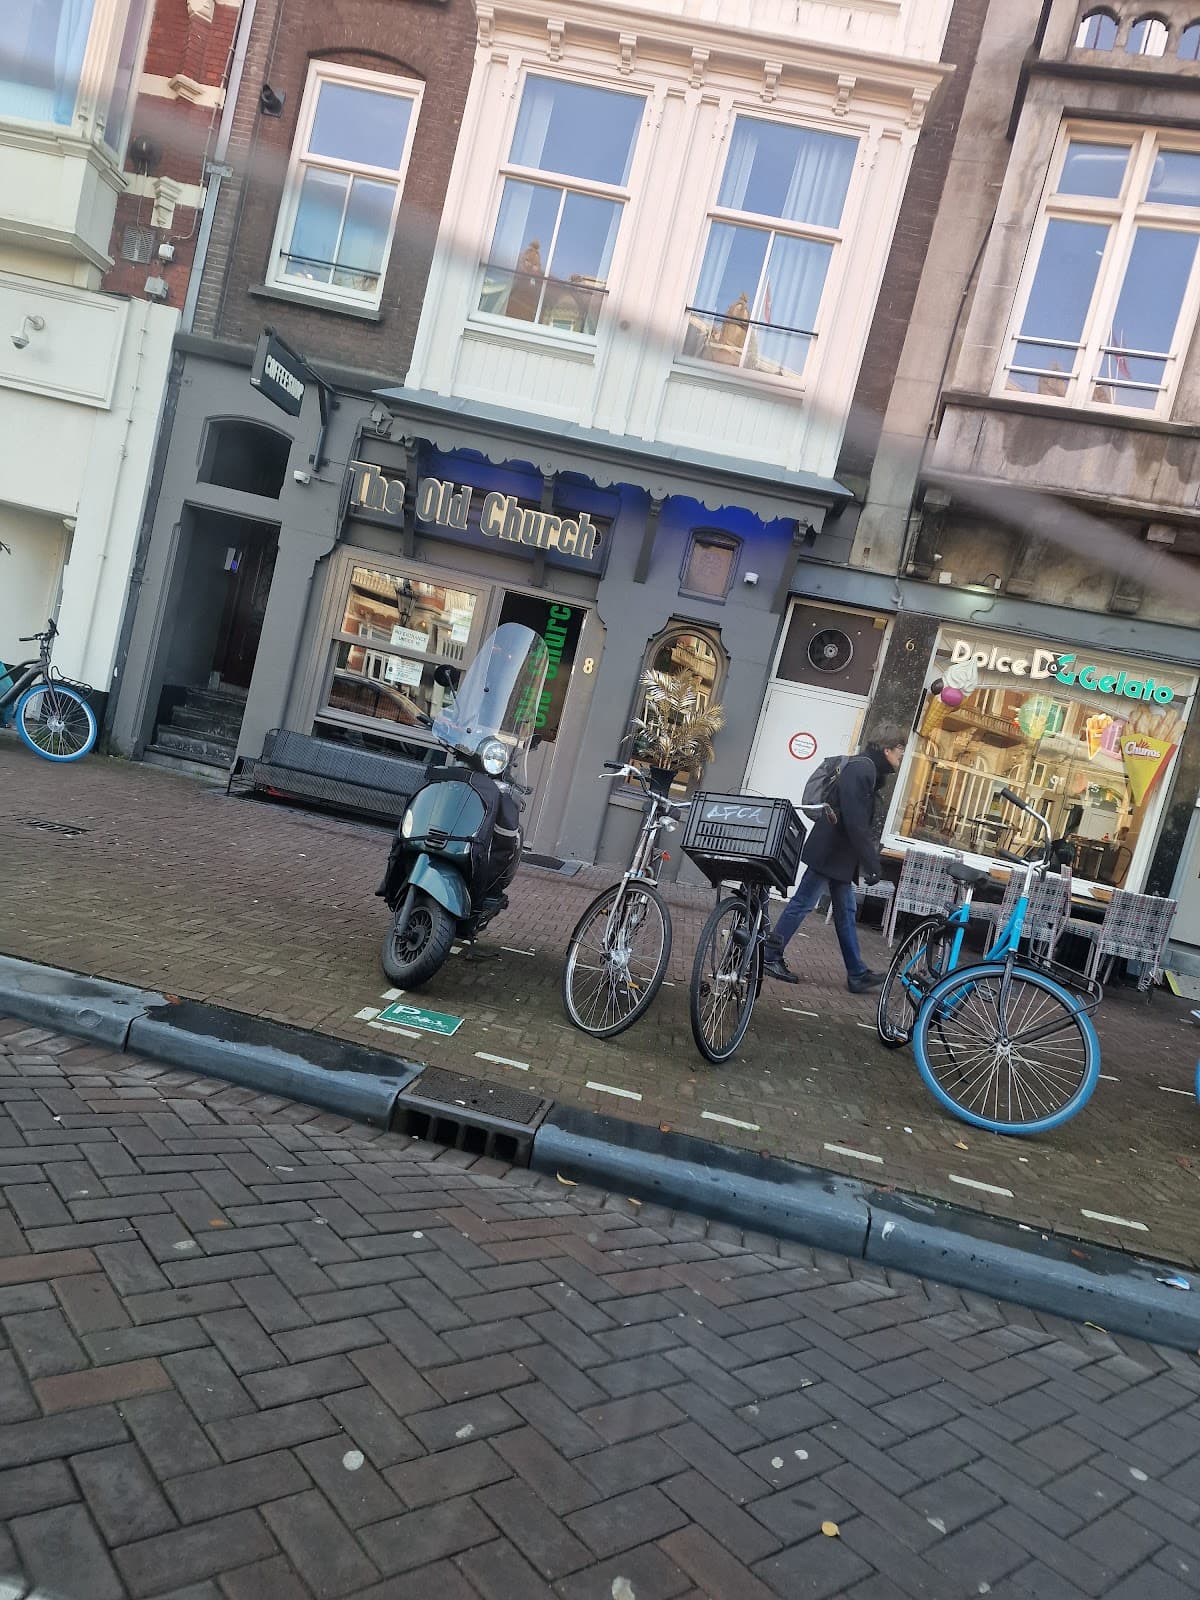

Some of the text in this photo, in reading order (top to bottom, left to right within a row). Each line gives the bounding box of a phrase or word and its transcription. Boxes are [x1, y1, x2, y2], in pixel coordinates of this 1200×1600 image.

[264, 354, 306, 401] COFFEESHOP
[349, 459, 596, 560] The Old Church
[905, 639, 915, 652] 6
[582, 656, 596, 674] 8
[951, 639, 1031, 677] Dolce
[1078, 665, 1175, 704] Gelato
[1123, 740, 1162, 760] Churros
[393, 1006, 421, 1015] P
